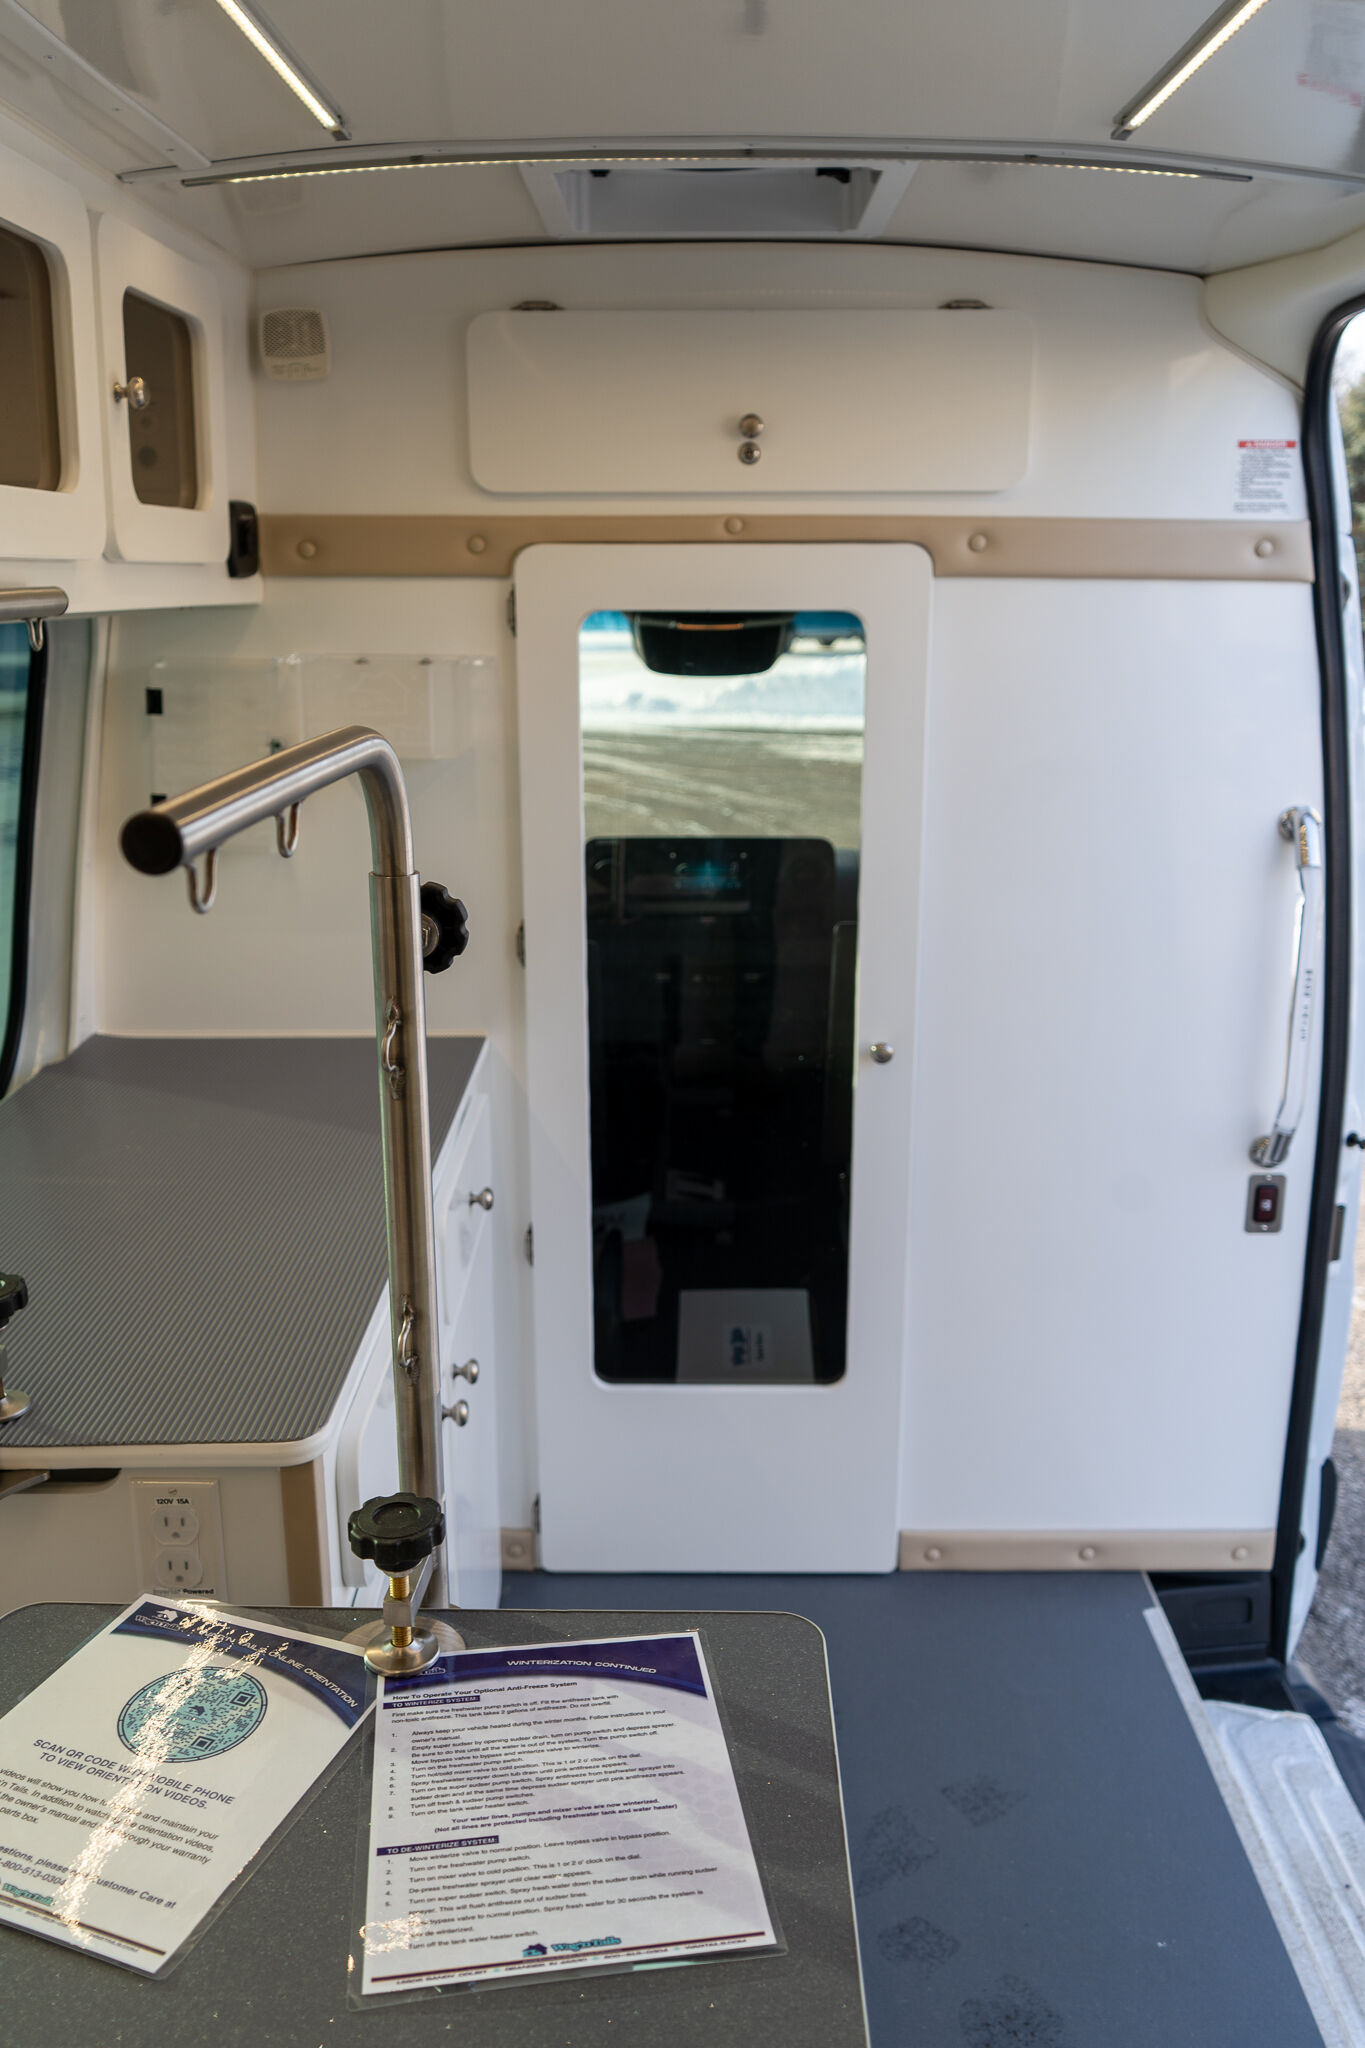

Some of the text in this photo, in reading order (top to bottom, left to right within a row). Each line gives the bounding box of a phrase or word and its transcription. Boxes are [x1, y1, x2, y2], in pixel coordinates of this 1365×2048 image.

[303, 1667, 358, 1708] ORIENTATION
[392, 1693, 410, 1701] How
[422, 1690, 452, 1699] Operate
[473, 1686, 504, 1695] Optional
[506, 1682, 548, 1691] Anti-Freeze
[550, 1680, 577, 1689] System
[594, 1661, 657, 1674] CONTINUED
[404, 1698, 443, 1707] WINTERIZE
[33, 1738, 66, 1755] SCAN
[65, 1747, 84, 1760] QR
[84, 1753, 117, 1770] CODE
[192, 1785, 234, 1805] PHONE
[39, 1751, 56, 1763] TO
[56, 1756, 86, 1772] VIEW
[163, 1789, 207, 1809] VIDEOS.
[8, 1782, 29, 1794] Tails.
[30, 1789, 41, 1798] In
[40, 1792, 74, 1809] addition
[138, 1822, 183, 1842] orientation
[14, 1797, 47, 1813] owner's
[47, 1807, 80, 1823] manual
[79, 1817, 98, 1829] and
[148, 1840, 171, 1854] your
[171, 1846, 211, 1866] warranty
[26, 1775, 42, 1786] will
[40, 1780, 63, 1792] show
[61, 1788, 80, 1800] you
[80, 1792, 99, 1803] how
[142, 1811, 161, 1823] and
[160, 1816, 197, 1834] maintain
[196, 1829, 218, 1842] your
[400, 1840, 459, 1852] DE-WINTERIZE
[34, 1856, 69, 1874] please
[138, 1889, 164, 1905] Care
[163, 1898, 177, 1909] at
